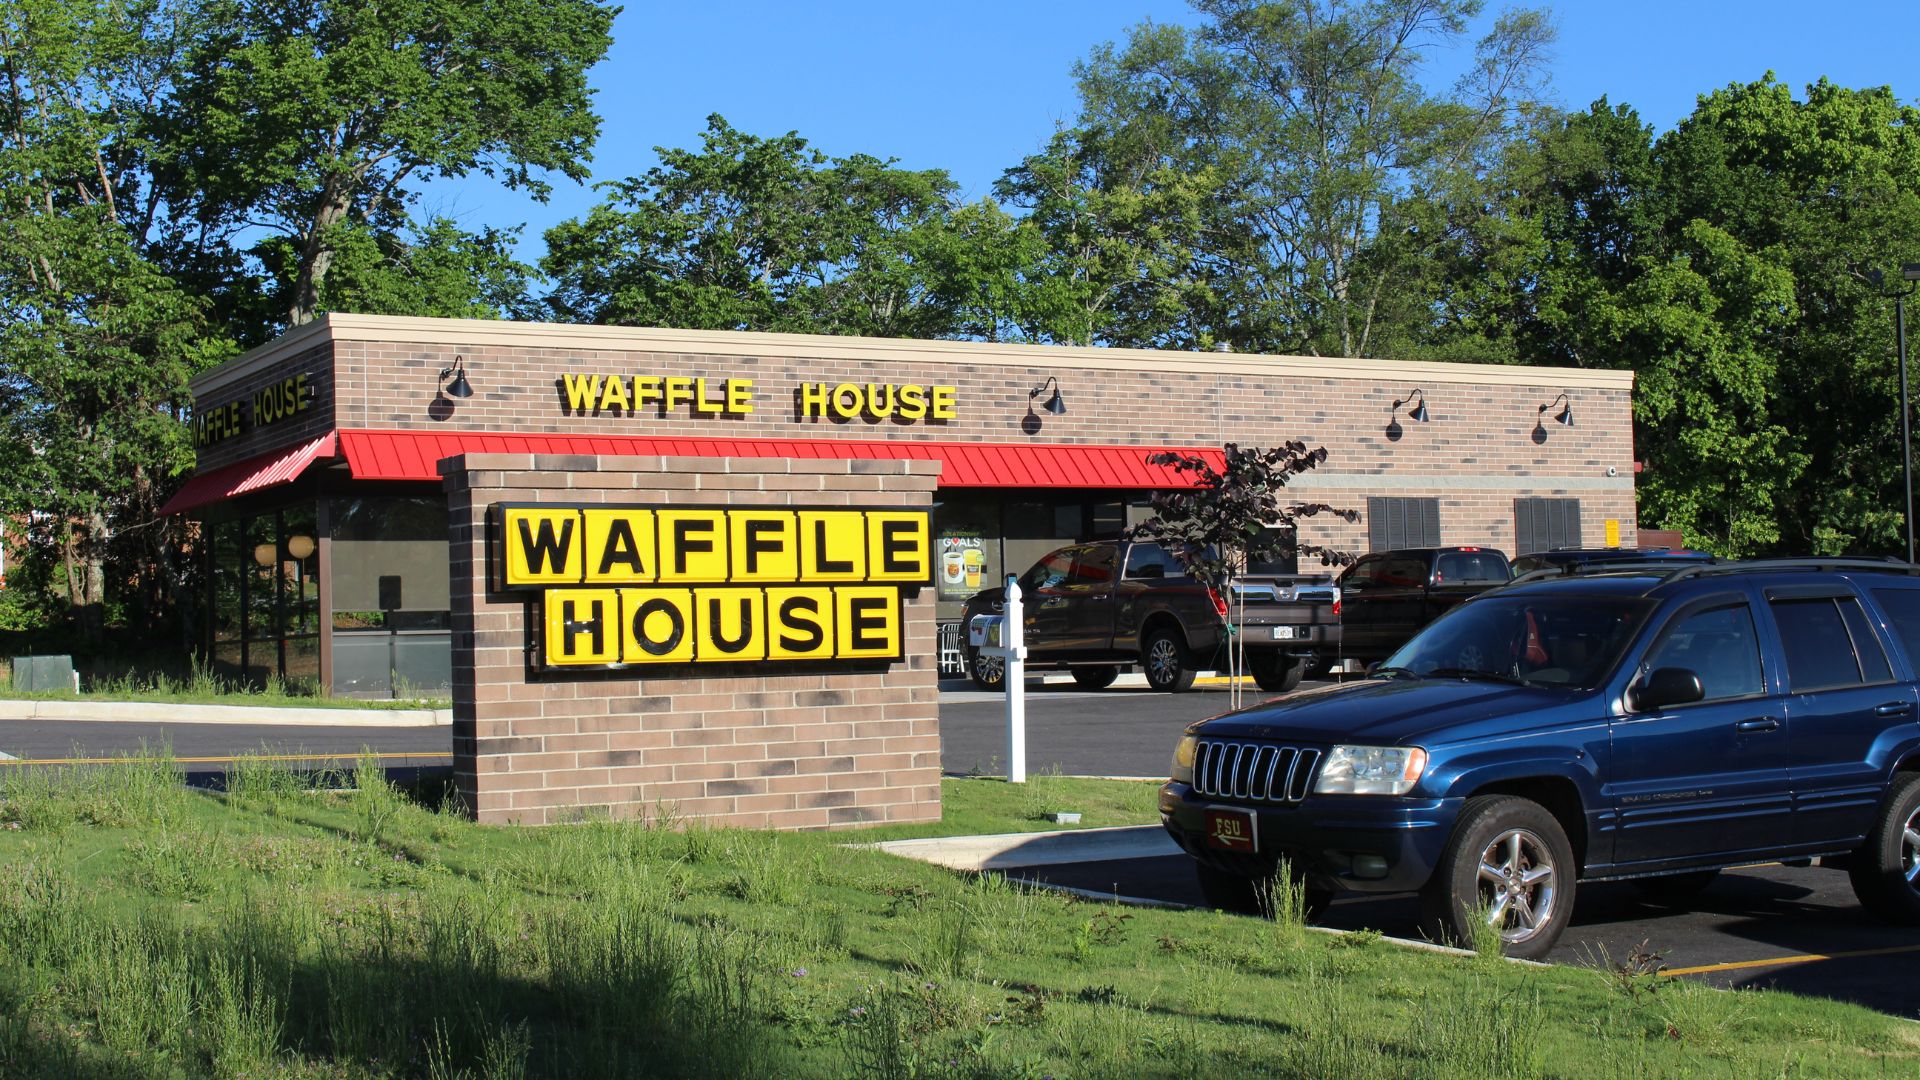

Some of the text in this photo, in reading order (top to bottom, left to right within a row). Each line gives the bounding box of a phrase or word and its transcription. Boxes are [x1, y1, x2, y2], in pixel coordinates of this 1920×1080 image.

[253, 374, 308, 428] HOUSE
[561, 373, 958, 420] WAFFLE HOUSE
[517, 518, 921, 575] WAFFLE
[562, 596, 890, 656] HOUSE
[1215, 818, 1241, 836] FSU
